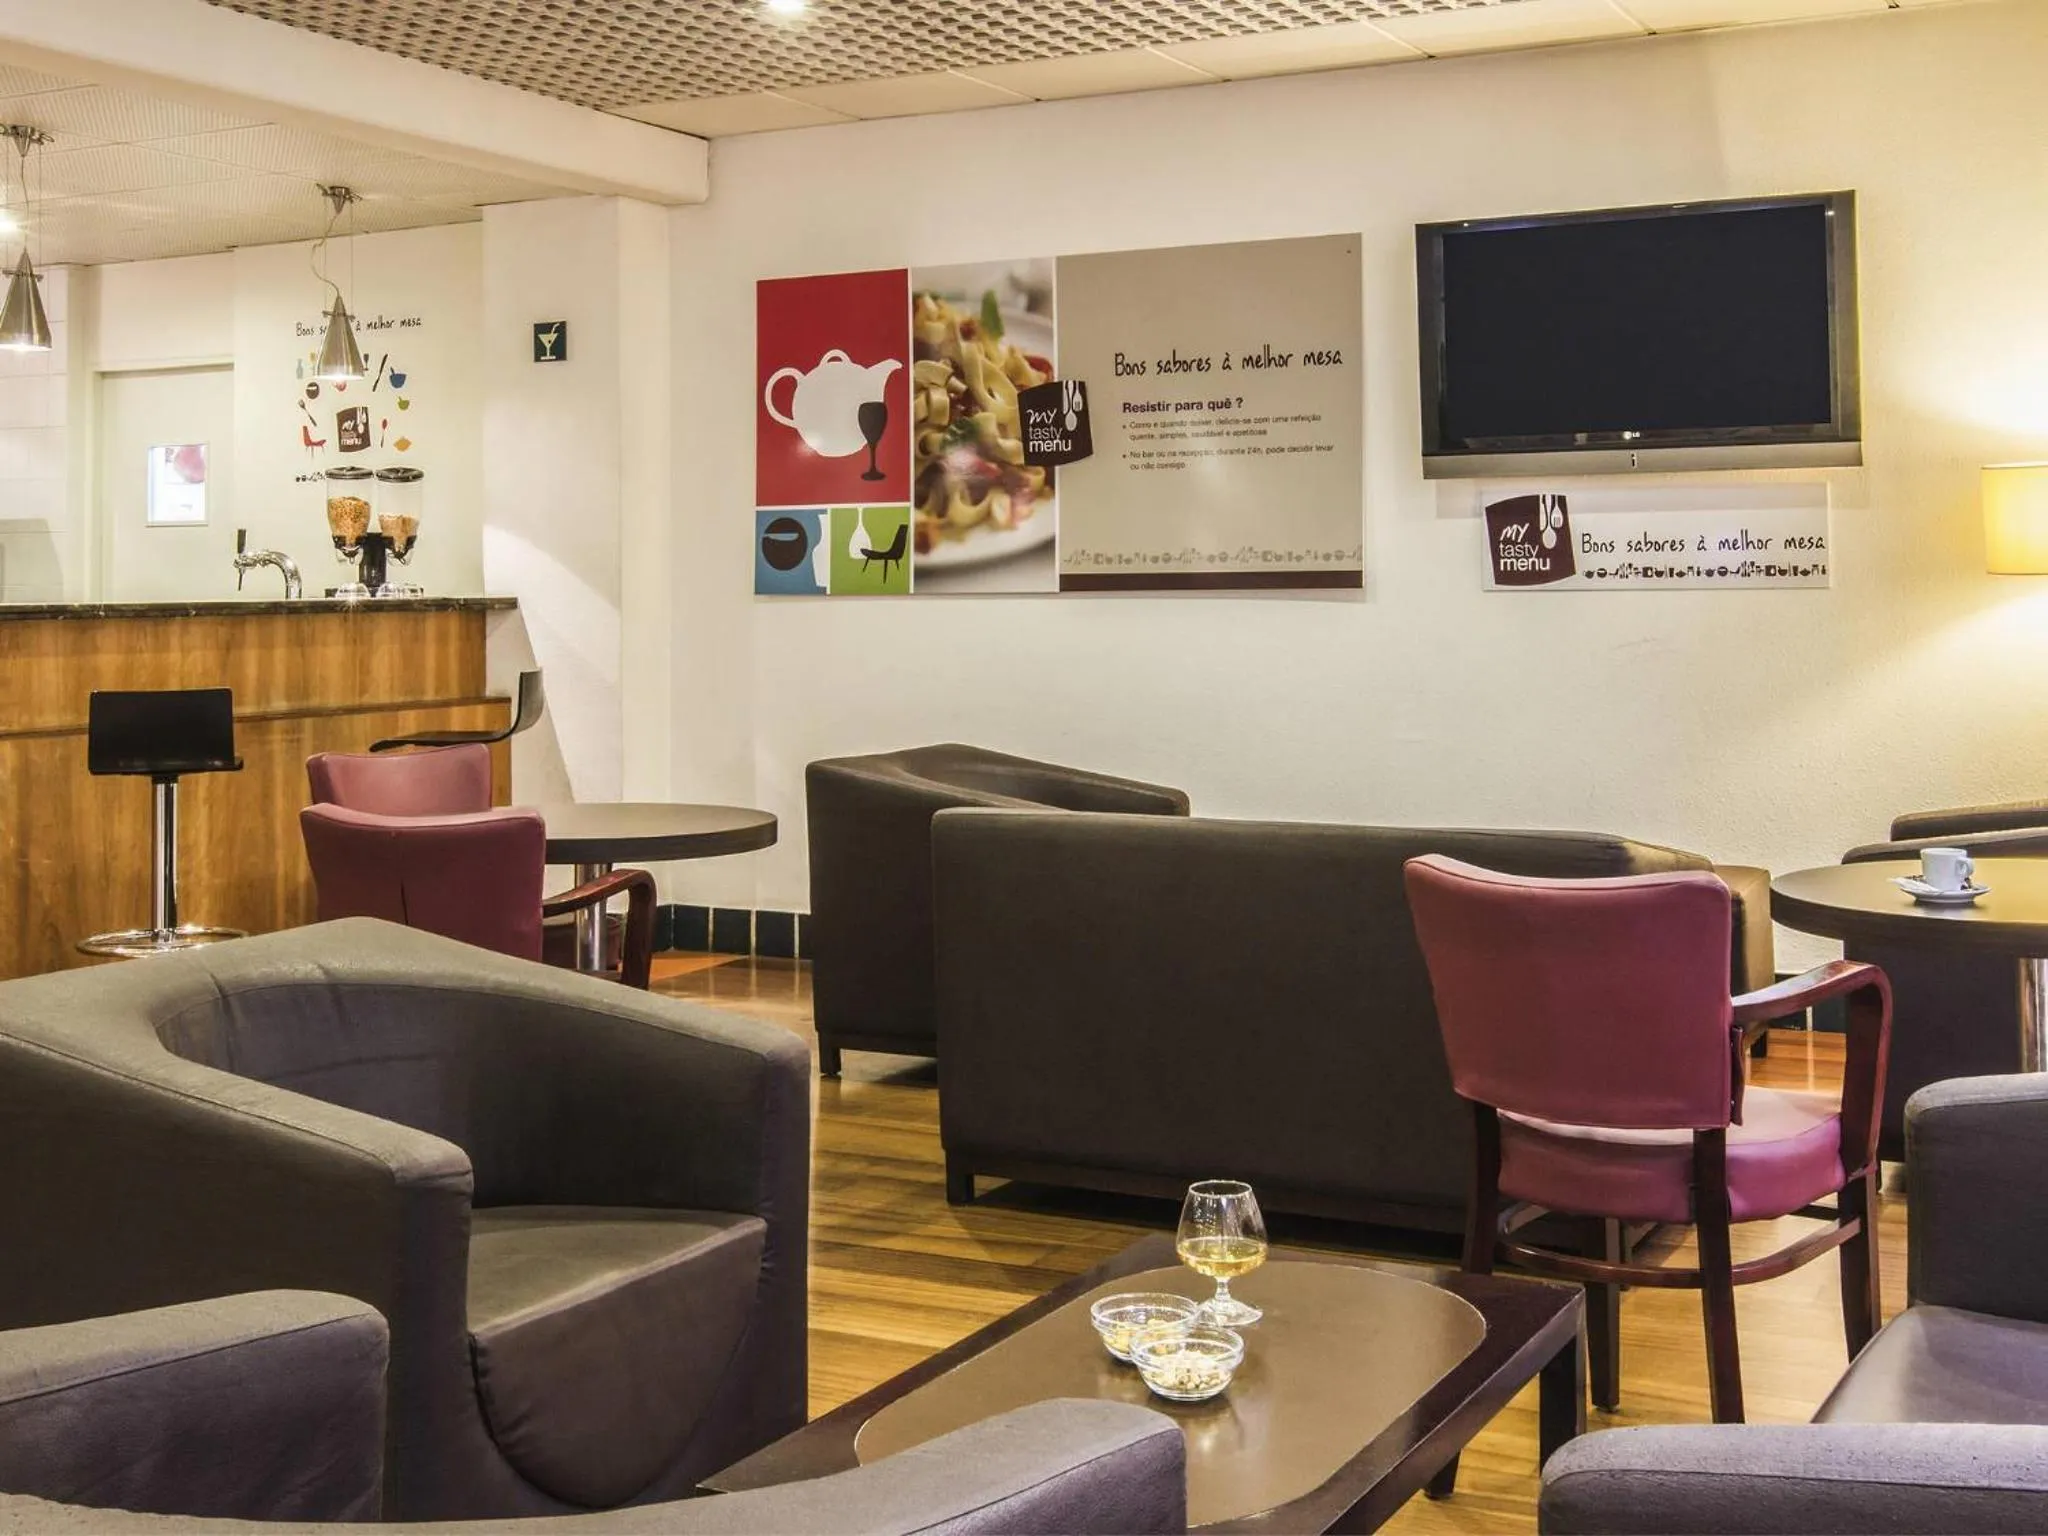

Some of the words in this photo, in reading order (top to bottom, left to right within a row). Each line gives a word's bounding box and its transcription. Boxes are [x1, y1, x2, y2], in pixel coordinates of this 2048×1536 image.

[399, 317, 422, 328] mesa
[1114, 352, 1147, 377] Bons
[1156, 348, 1212, 373] sabores
[1221, 352, 1232, 371] à
[1241, 343, 1294, 369] melhor
[1303, 350, 1343, 367] mesa
[1122, 400, 1171, 413] Resistir
[1174, 401, 1203, 413] para
[1207, 398, 1232, 412] quê
[1235, 397, 1244, 409] ?
[1026, 408, 1057, 424] my
[1029, 425, 1062, 440] tasty
[1029, 439, 1071, 453] menu
[1500, 522, 1530, 543] my
[1582, 533, 1615, 553] Bons
[1627, 531, 1685, 552] sabores
[1697, 535, 1707, 551] à
[1718, 529, 1773, 550] melhor
[1784, 536, 1826, 549] mesa
[1499, 543, 1539, 558] tasty
[1500, 558, 1550, 571] menu
